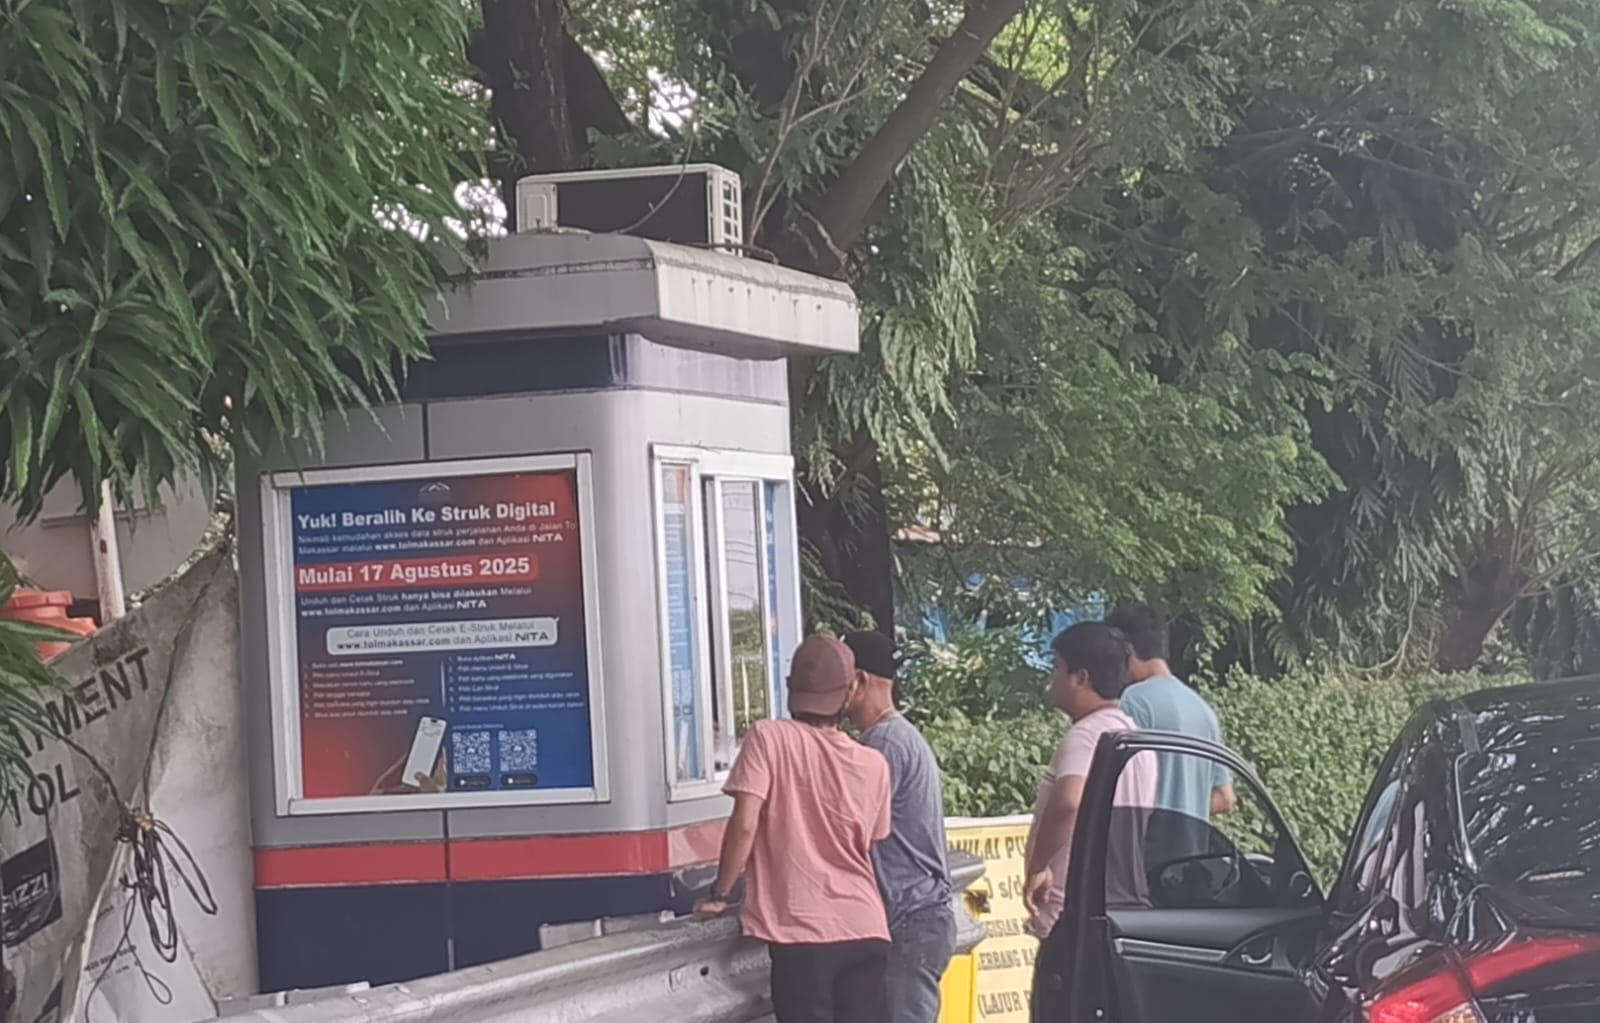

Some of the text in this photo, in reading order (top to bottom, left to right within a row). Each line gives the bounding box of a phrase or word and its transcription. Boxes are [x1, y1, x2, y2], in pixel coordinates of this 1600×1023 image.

[298, 501, 556, 529] Yuk! Beralih Ke Struk Digital
[532, 532, 564, 543] NITA
[299, 557, 531, 585] Mulai 17 Agustus 2025
[456, 599, 488, 610] NITA
[514, 630, 550, 641] NITA
